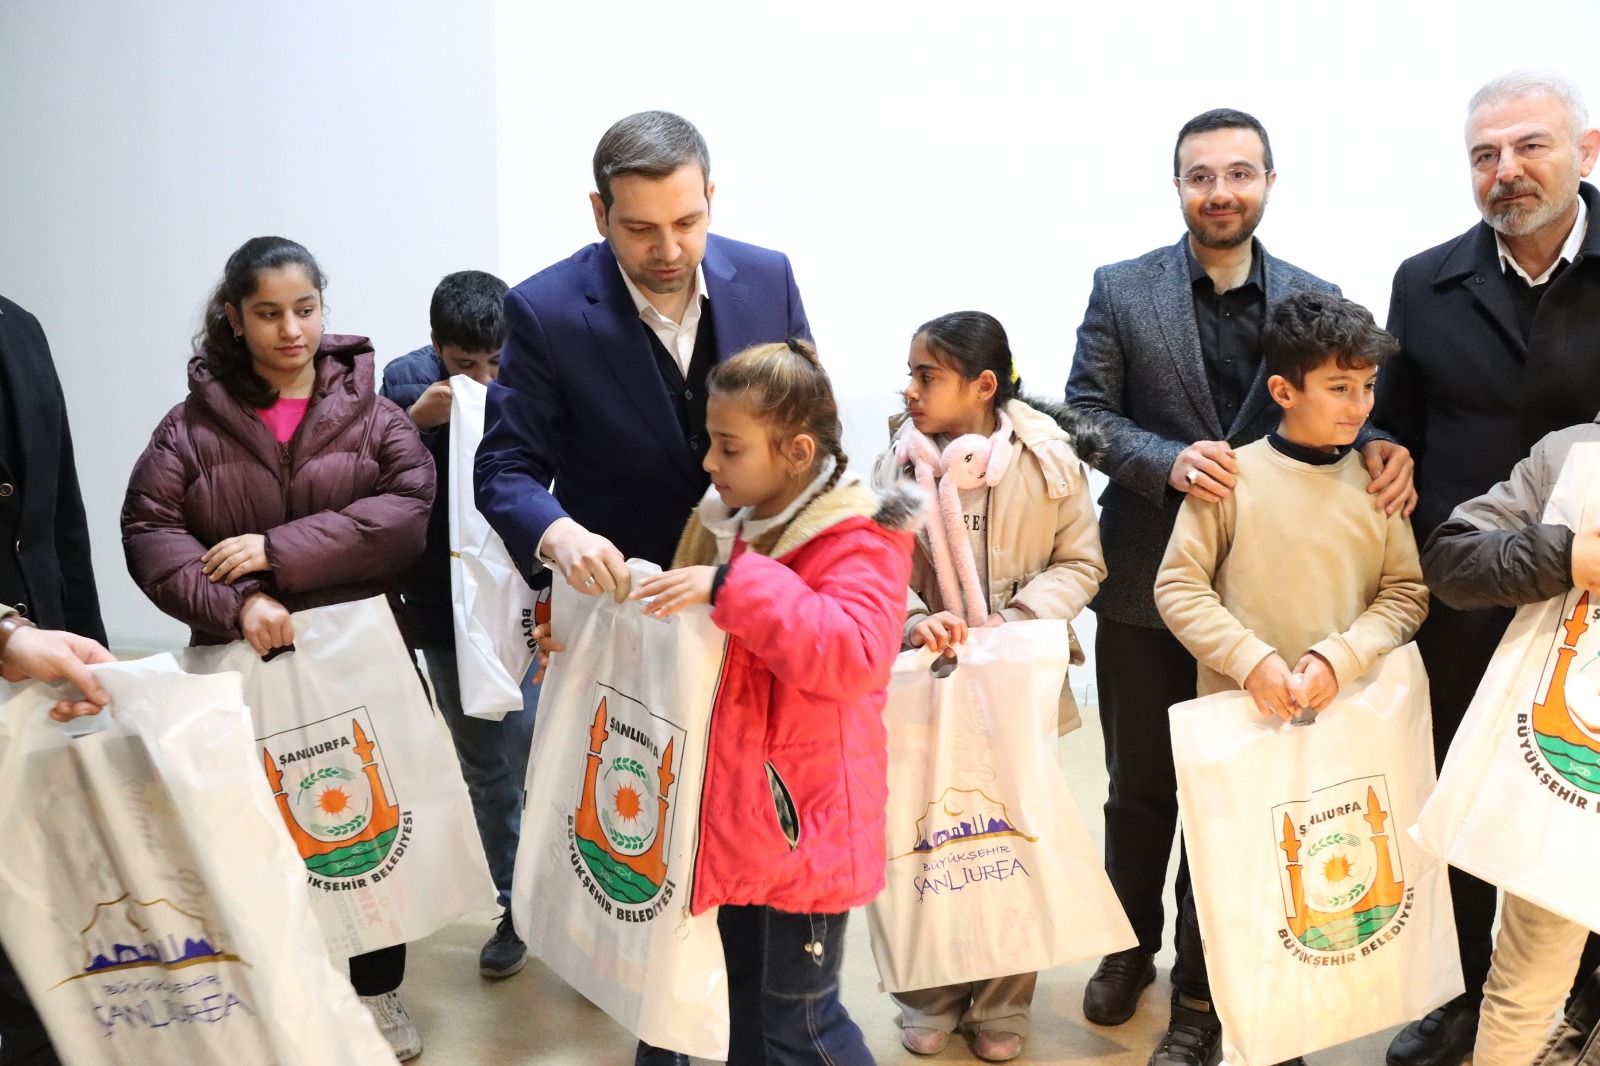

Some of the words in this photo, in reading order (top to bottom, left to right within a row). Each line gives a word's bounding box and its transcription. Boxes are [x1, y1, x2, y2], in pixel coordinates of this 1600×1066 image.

[278, 735, 351, 768] ŞANLIURFA
[1517, 713, 1588, 810] BÜYÜKŞEHİR
[370, 810, 413, 885] BELEDİYESİ
[1299, 801, 1362, 838] ŞNLIURFA
[567, 815, 612, 915] BÜYÜKŞEHİR
[913, 857, 1031, 904] ŞANLIURFA
[922, 845, 1011, 872] BÜYÜKŞEHİR
[1360, 886, 1415, 957] BELEDİYESİ
